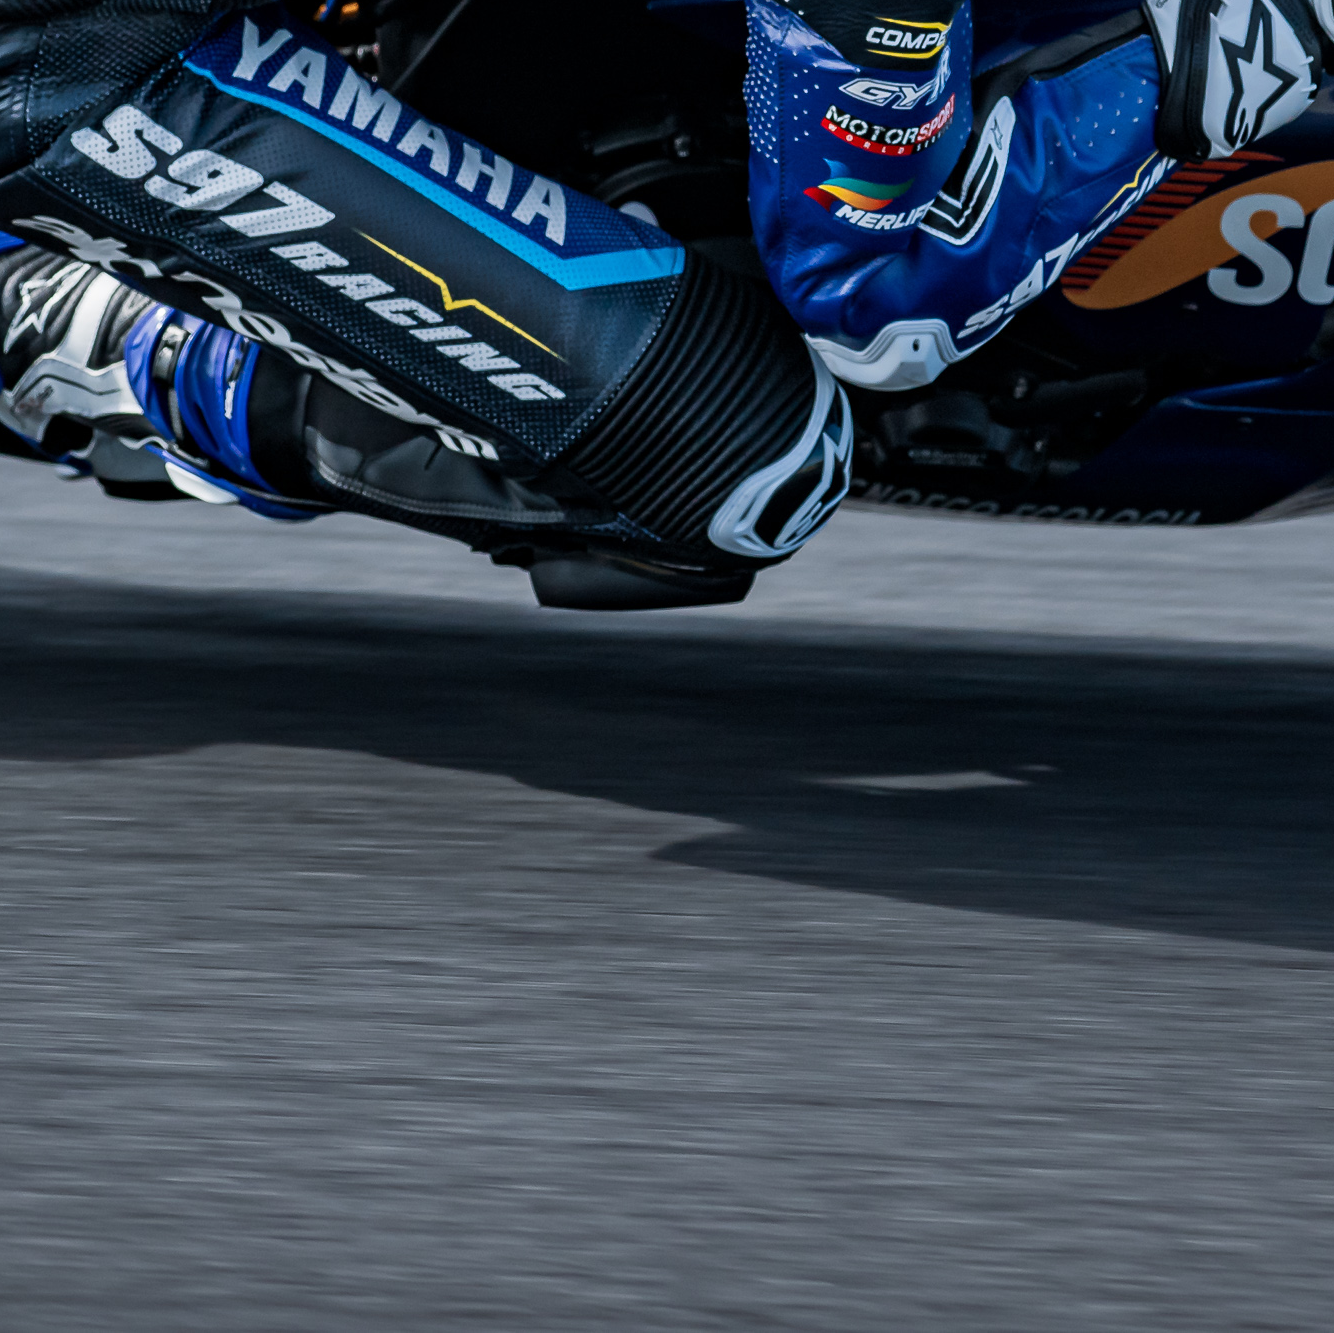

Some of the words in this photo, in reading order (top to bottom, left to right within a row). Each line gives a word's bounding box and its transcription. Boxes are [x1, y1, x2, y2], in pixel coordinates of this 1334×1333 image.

[231, 16, 567, 246] YAMAHA
[827, 123, 905, 155] WORLD
[70, 103, 336, 238] S97
[268, 241, 567, 401] RACING
[956, 232, 1079, 340] S97
